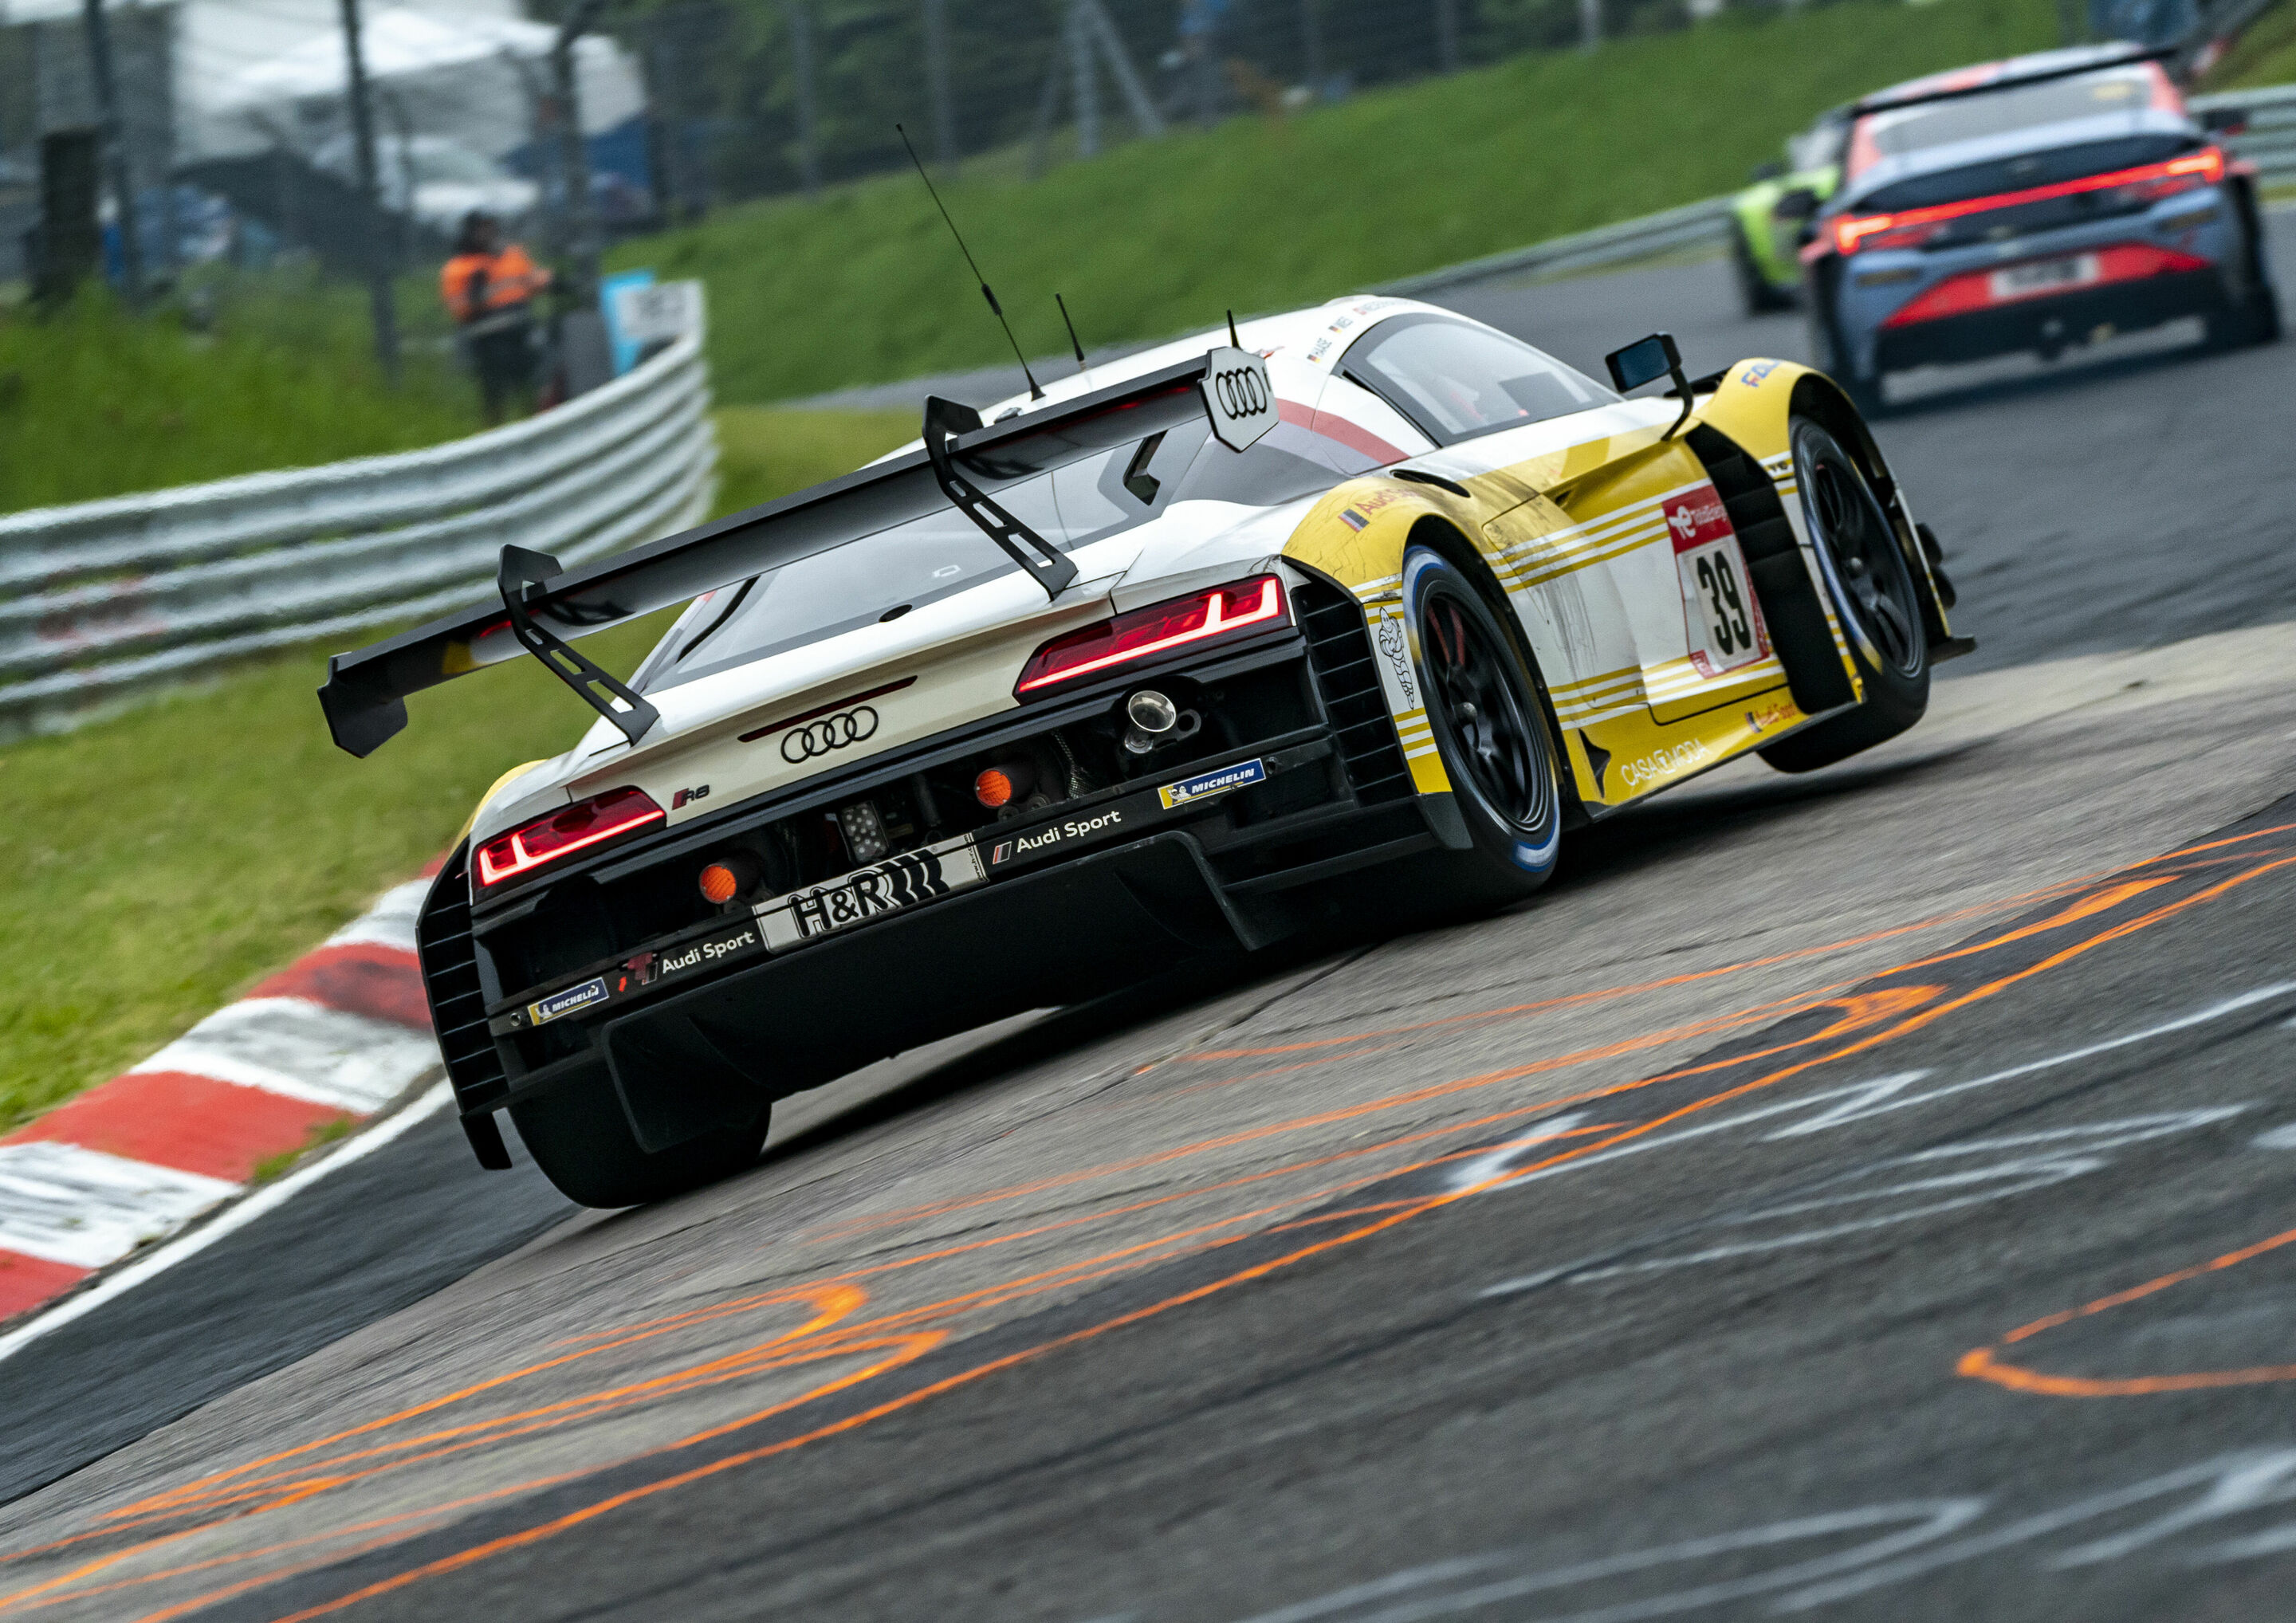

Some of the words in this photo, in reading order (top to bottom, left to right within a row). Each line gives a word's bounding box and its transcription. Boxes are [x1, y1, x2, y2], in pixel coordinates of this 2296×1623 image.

[1697, 551, 1751, 655] 39
[679, 784, 710, 807] R8
[1192, 768, 1255, 794] MICHELIN
[1016, 827, 1060, 853] Audi
[1064, 811, 1122, 838] Sport
[662, 949, 701, 973] Audi
[703, 931, 755, 959] Sport
